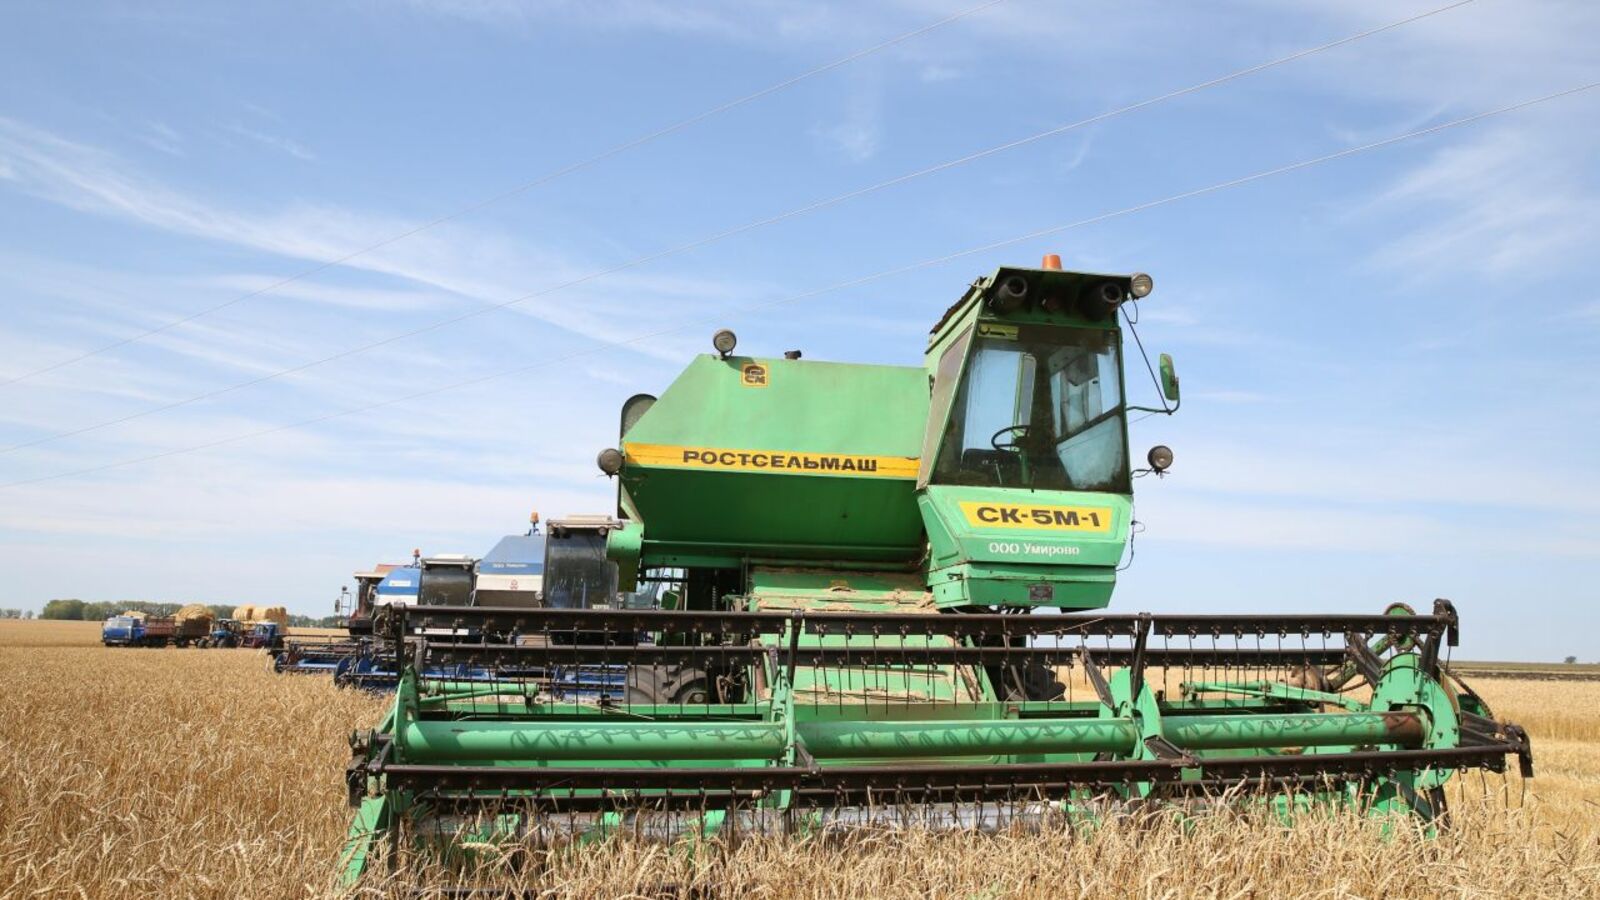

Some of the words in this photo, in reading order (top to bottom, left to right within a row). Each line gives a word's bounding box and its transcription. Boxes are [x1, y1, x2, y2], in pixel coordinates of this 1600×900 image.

[683, 450, 877, 472] РОСТСЕЛЬМАШ
[977, 507, 1100, 527] СК-5М-1
[989, 542, 1020, 554] ООО
